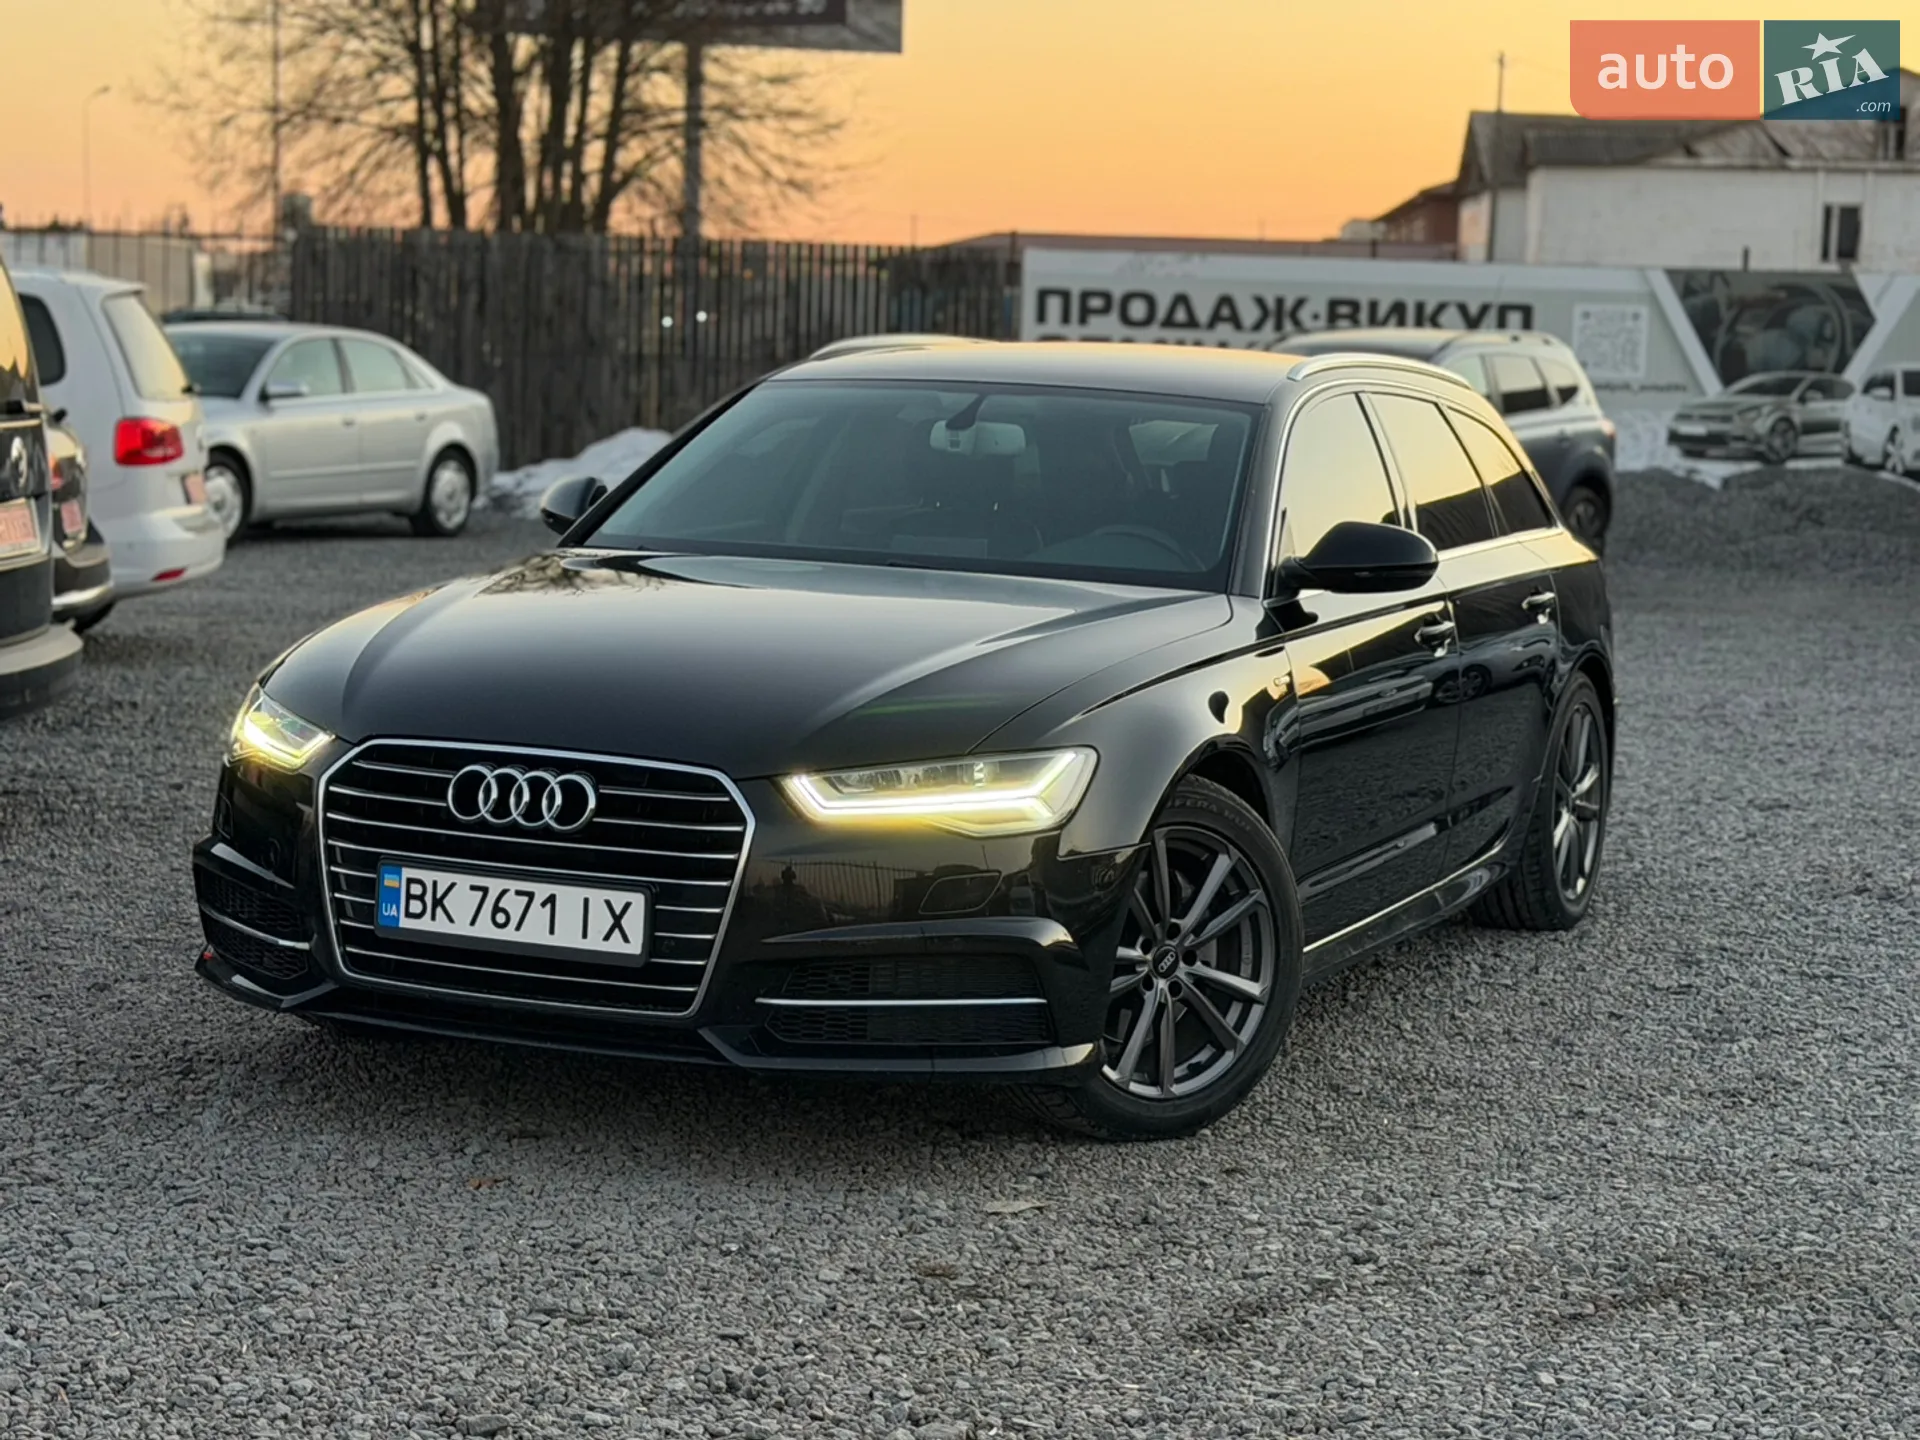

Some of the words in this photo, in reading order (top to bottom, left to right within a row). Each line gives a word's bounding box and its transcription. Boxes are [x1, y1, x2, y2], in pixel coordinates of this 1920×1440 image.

[382, 902, 398, 917] UA
[403, 877, 458, 925] BK
[468, 884, 557, 936] 7671
[581, 897, 633, 944] IX
